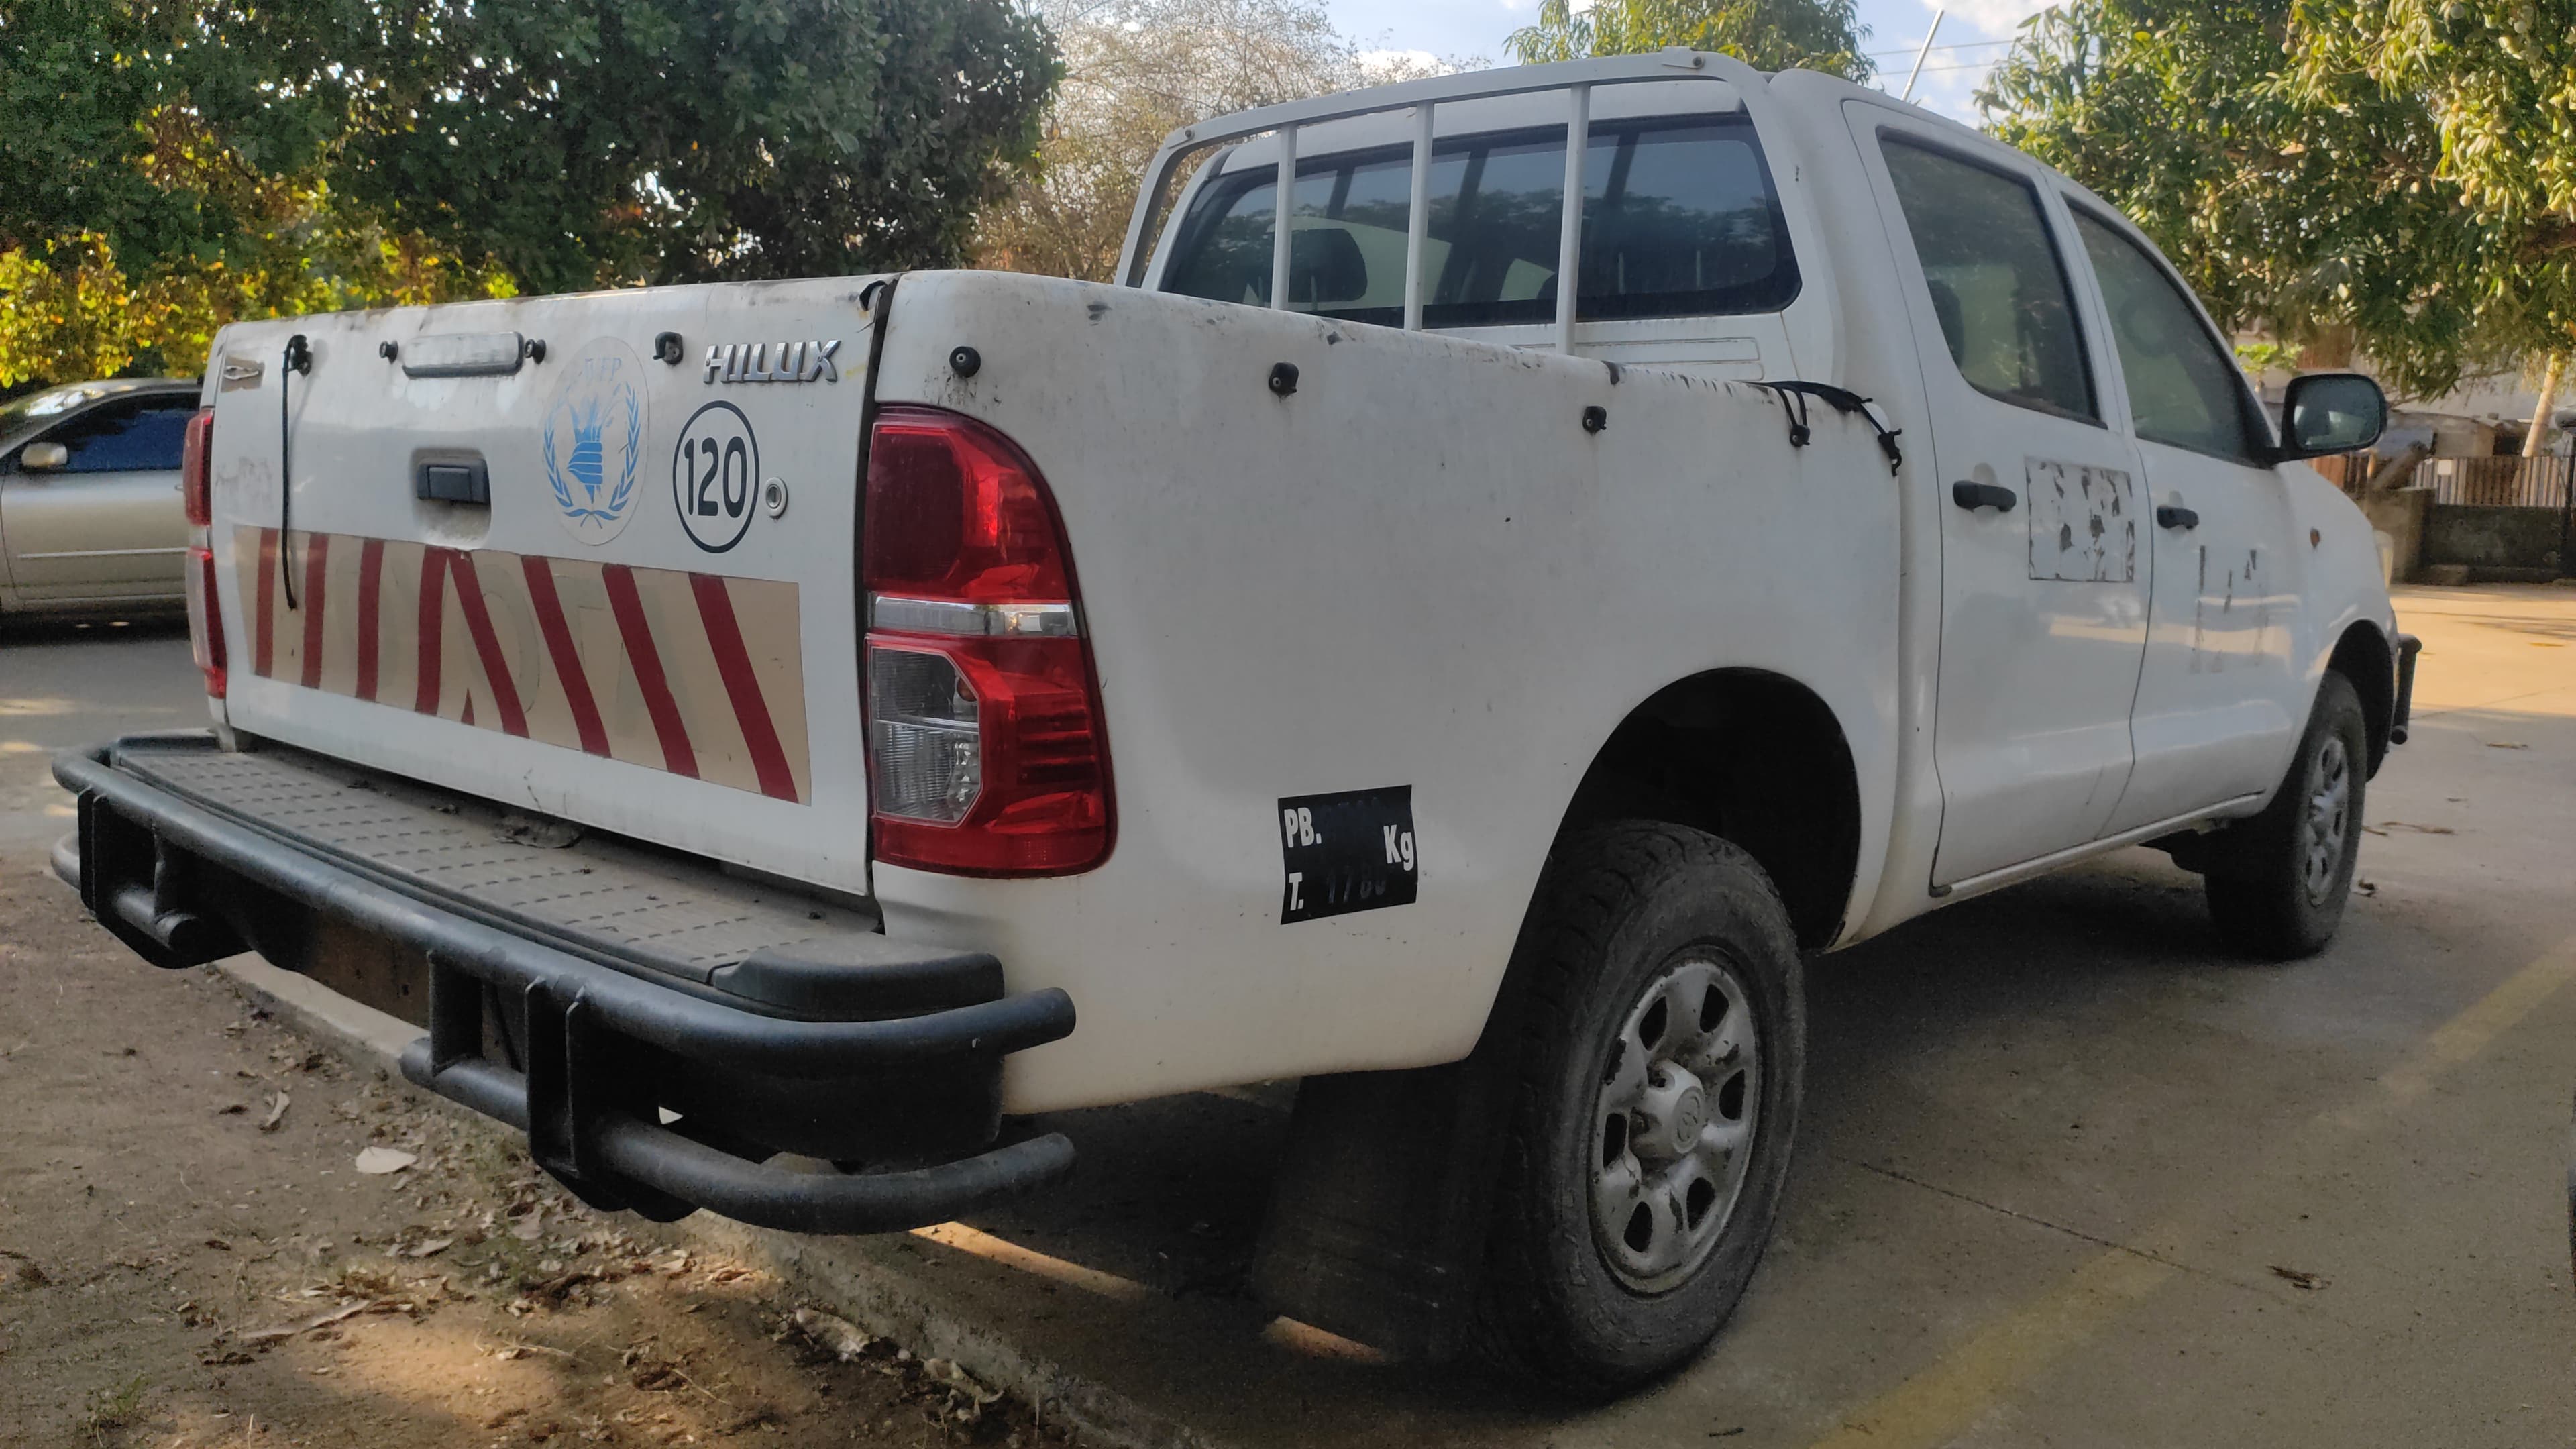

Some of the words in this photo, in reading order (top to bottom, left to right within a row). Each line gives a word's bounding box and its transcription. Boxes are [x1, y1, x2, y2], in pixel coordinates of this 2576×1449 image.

[703, 339, 841, 384] HILUX
[684, 436, 747, 519] 120
[1284, 807, 1322, 848] PB.
[1383, 824, 1414, 871] Kg
[1289, 872, 1304, 911] T.
